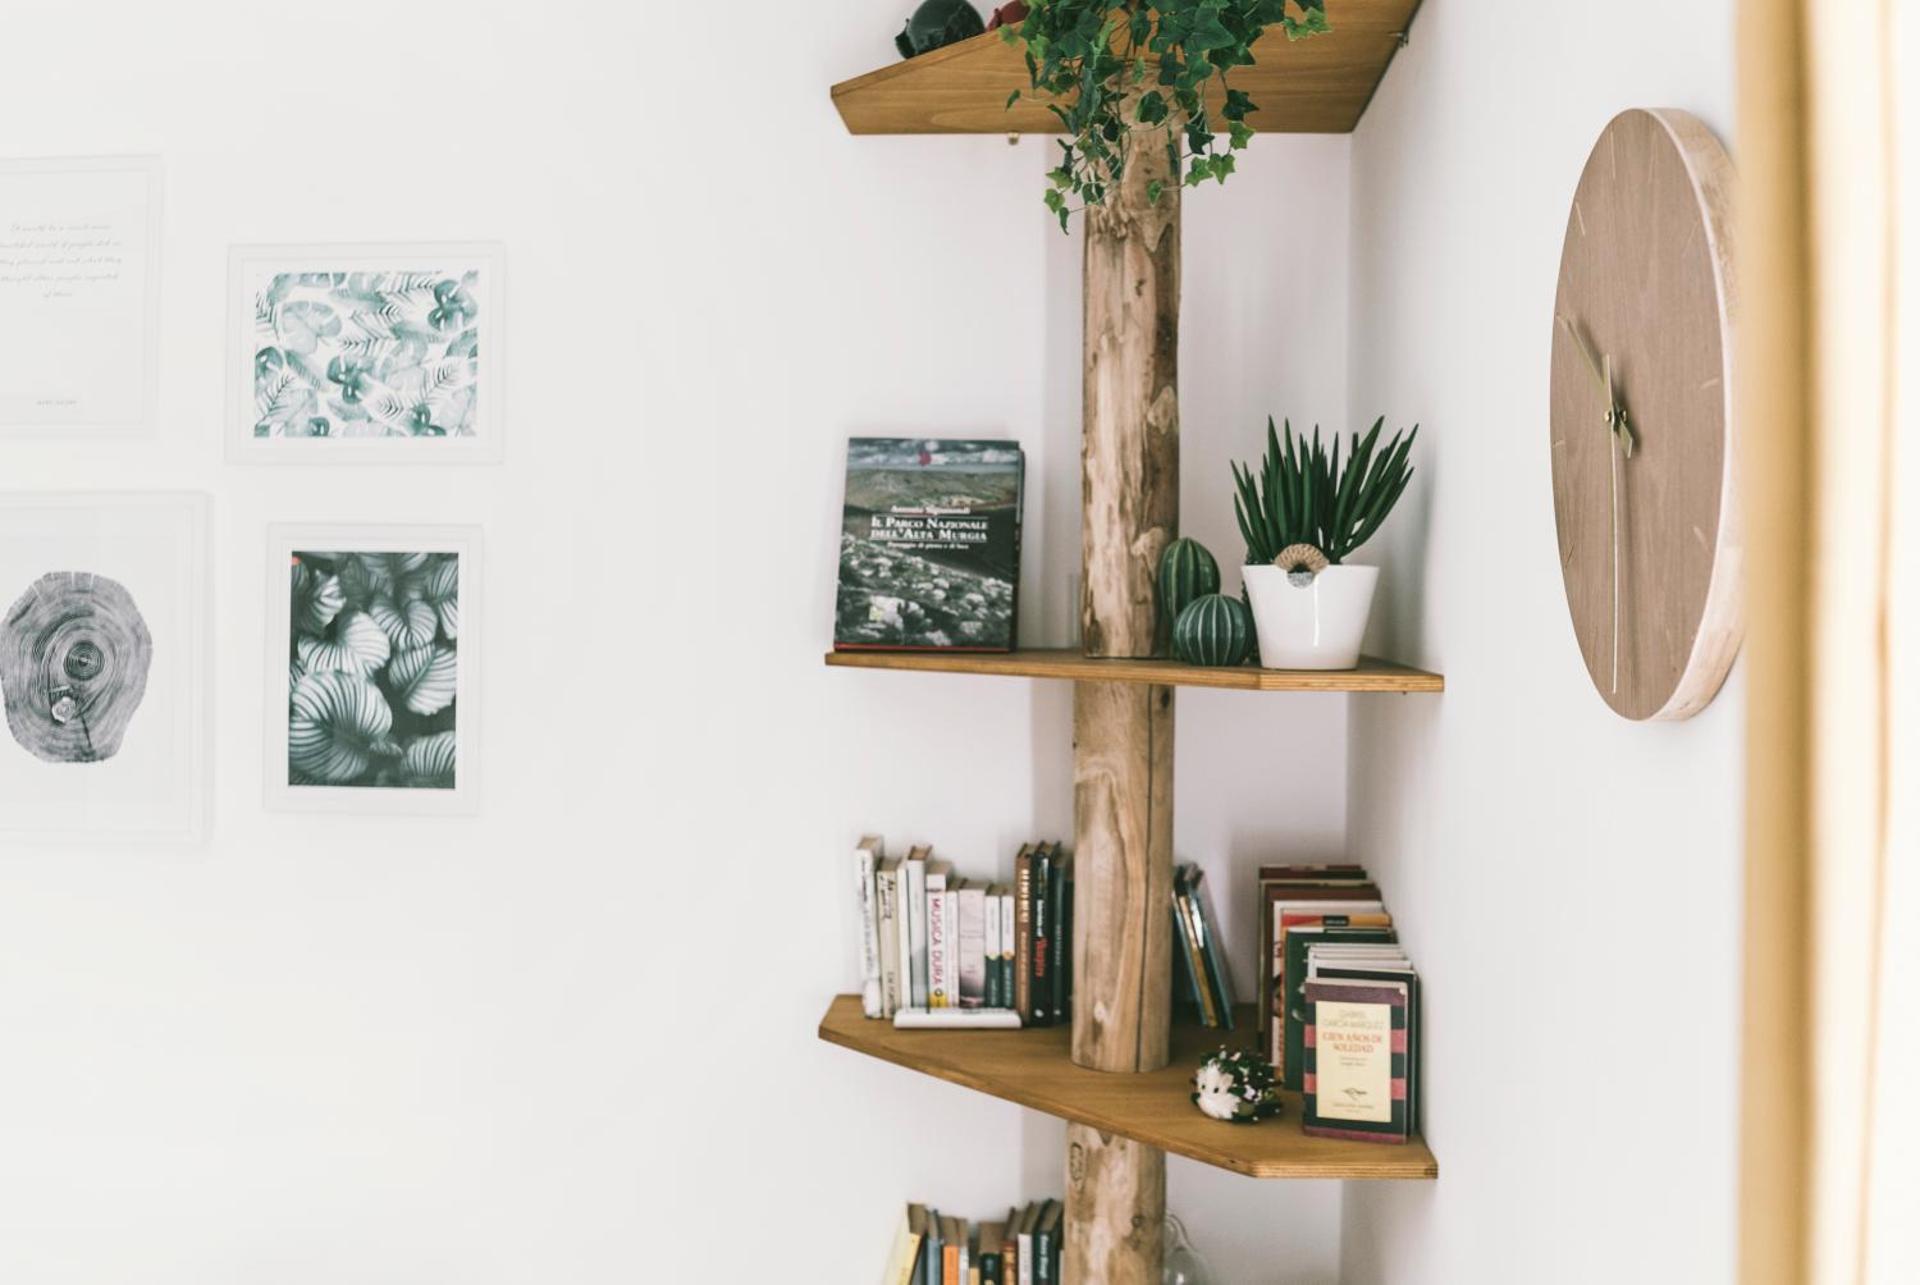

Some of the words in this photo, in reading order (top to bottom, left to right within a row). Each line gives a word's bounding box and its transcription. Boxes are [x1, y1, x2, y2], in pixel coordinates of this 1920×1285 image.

[886, 516, 924, 528] PARCO
[926, 517, 988, 529] NAZIONALE
[939, 529, 987, 541] MURGIA
[931, 899, 942, 945] MUSICA
[932, 950, 943, 985] DURA
